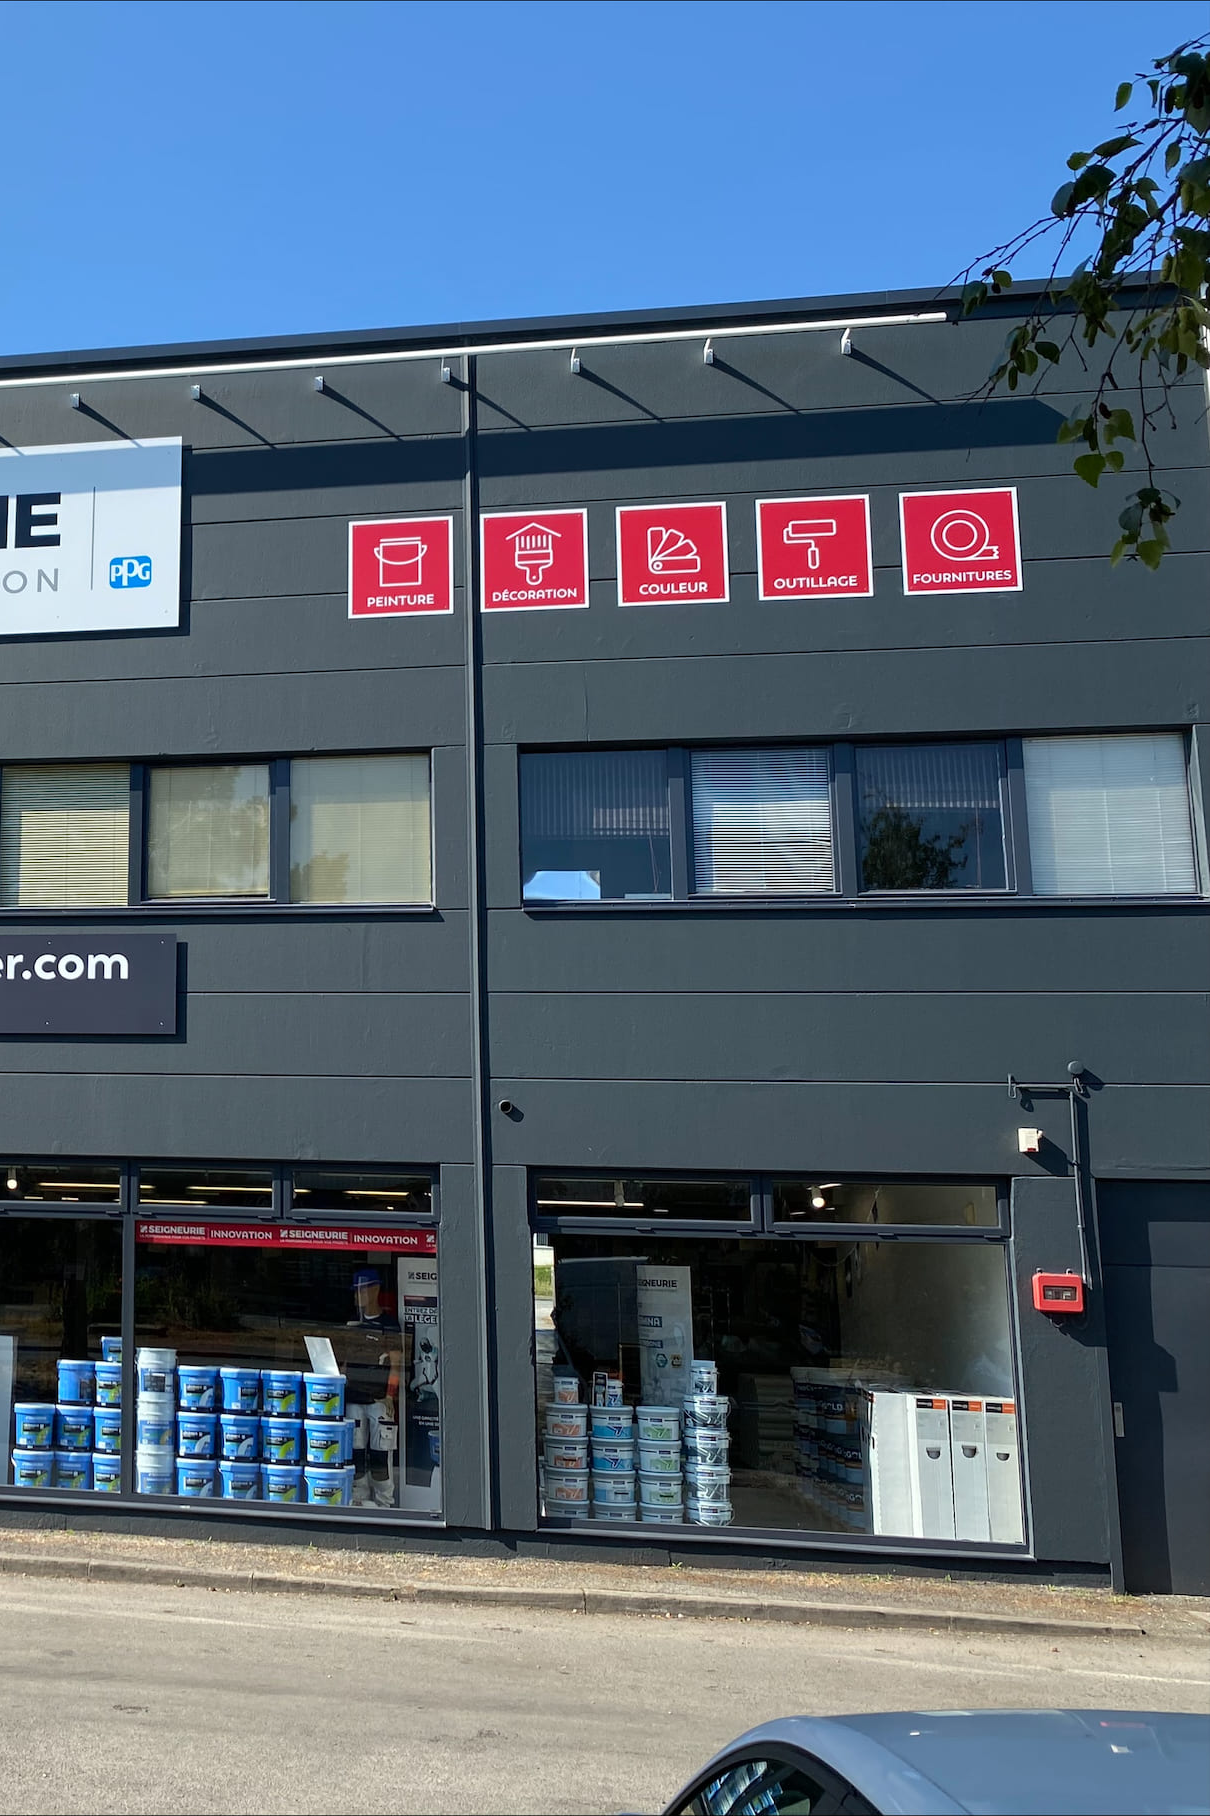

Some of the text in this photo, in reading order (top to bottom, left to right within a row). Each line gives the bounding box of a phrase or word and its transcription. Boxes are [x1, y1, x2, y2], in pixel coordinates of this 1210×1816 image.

[110, 558, 151, 587] PPG
[912, 567, 1013, 585] FOURNITURES
[638, 580, 709, 596] COULEUR
[773, 573, 858, 590] OUTILLAGE
[366, 593, 435, 608] PEINTURE
[491, 584, 578, 602] DÉCORATION
[149, 1225, 205, 1235] SEIGNEURIE
[211, 1230, 272, 1240] INNOVATION
[289, 1229, 348, 1240] SEIGNEURIE
[354, 1234, 418, 1245] INNOVATION
